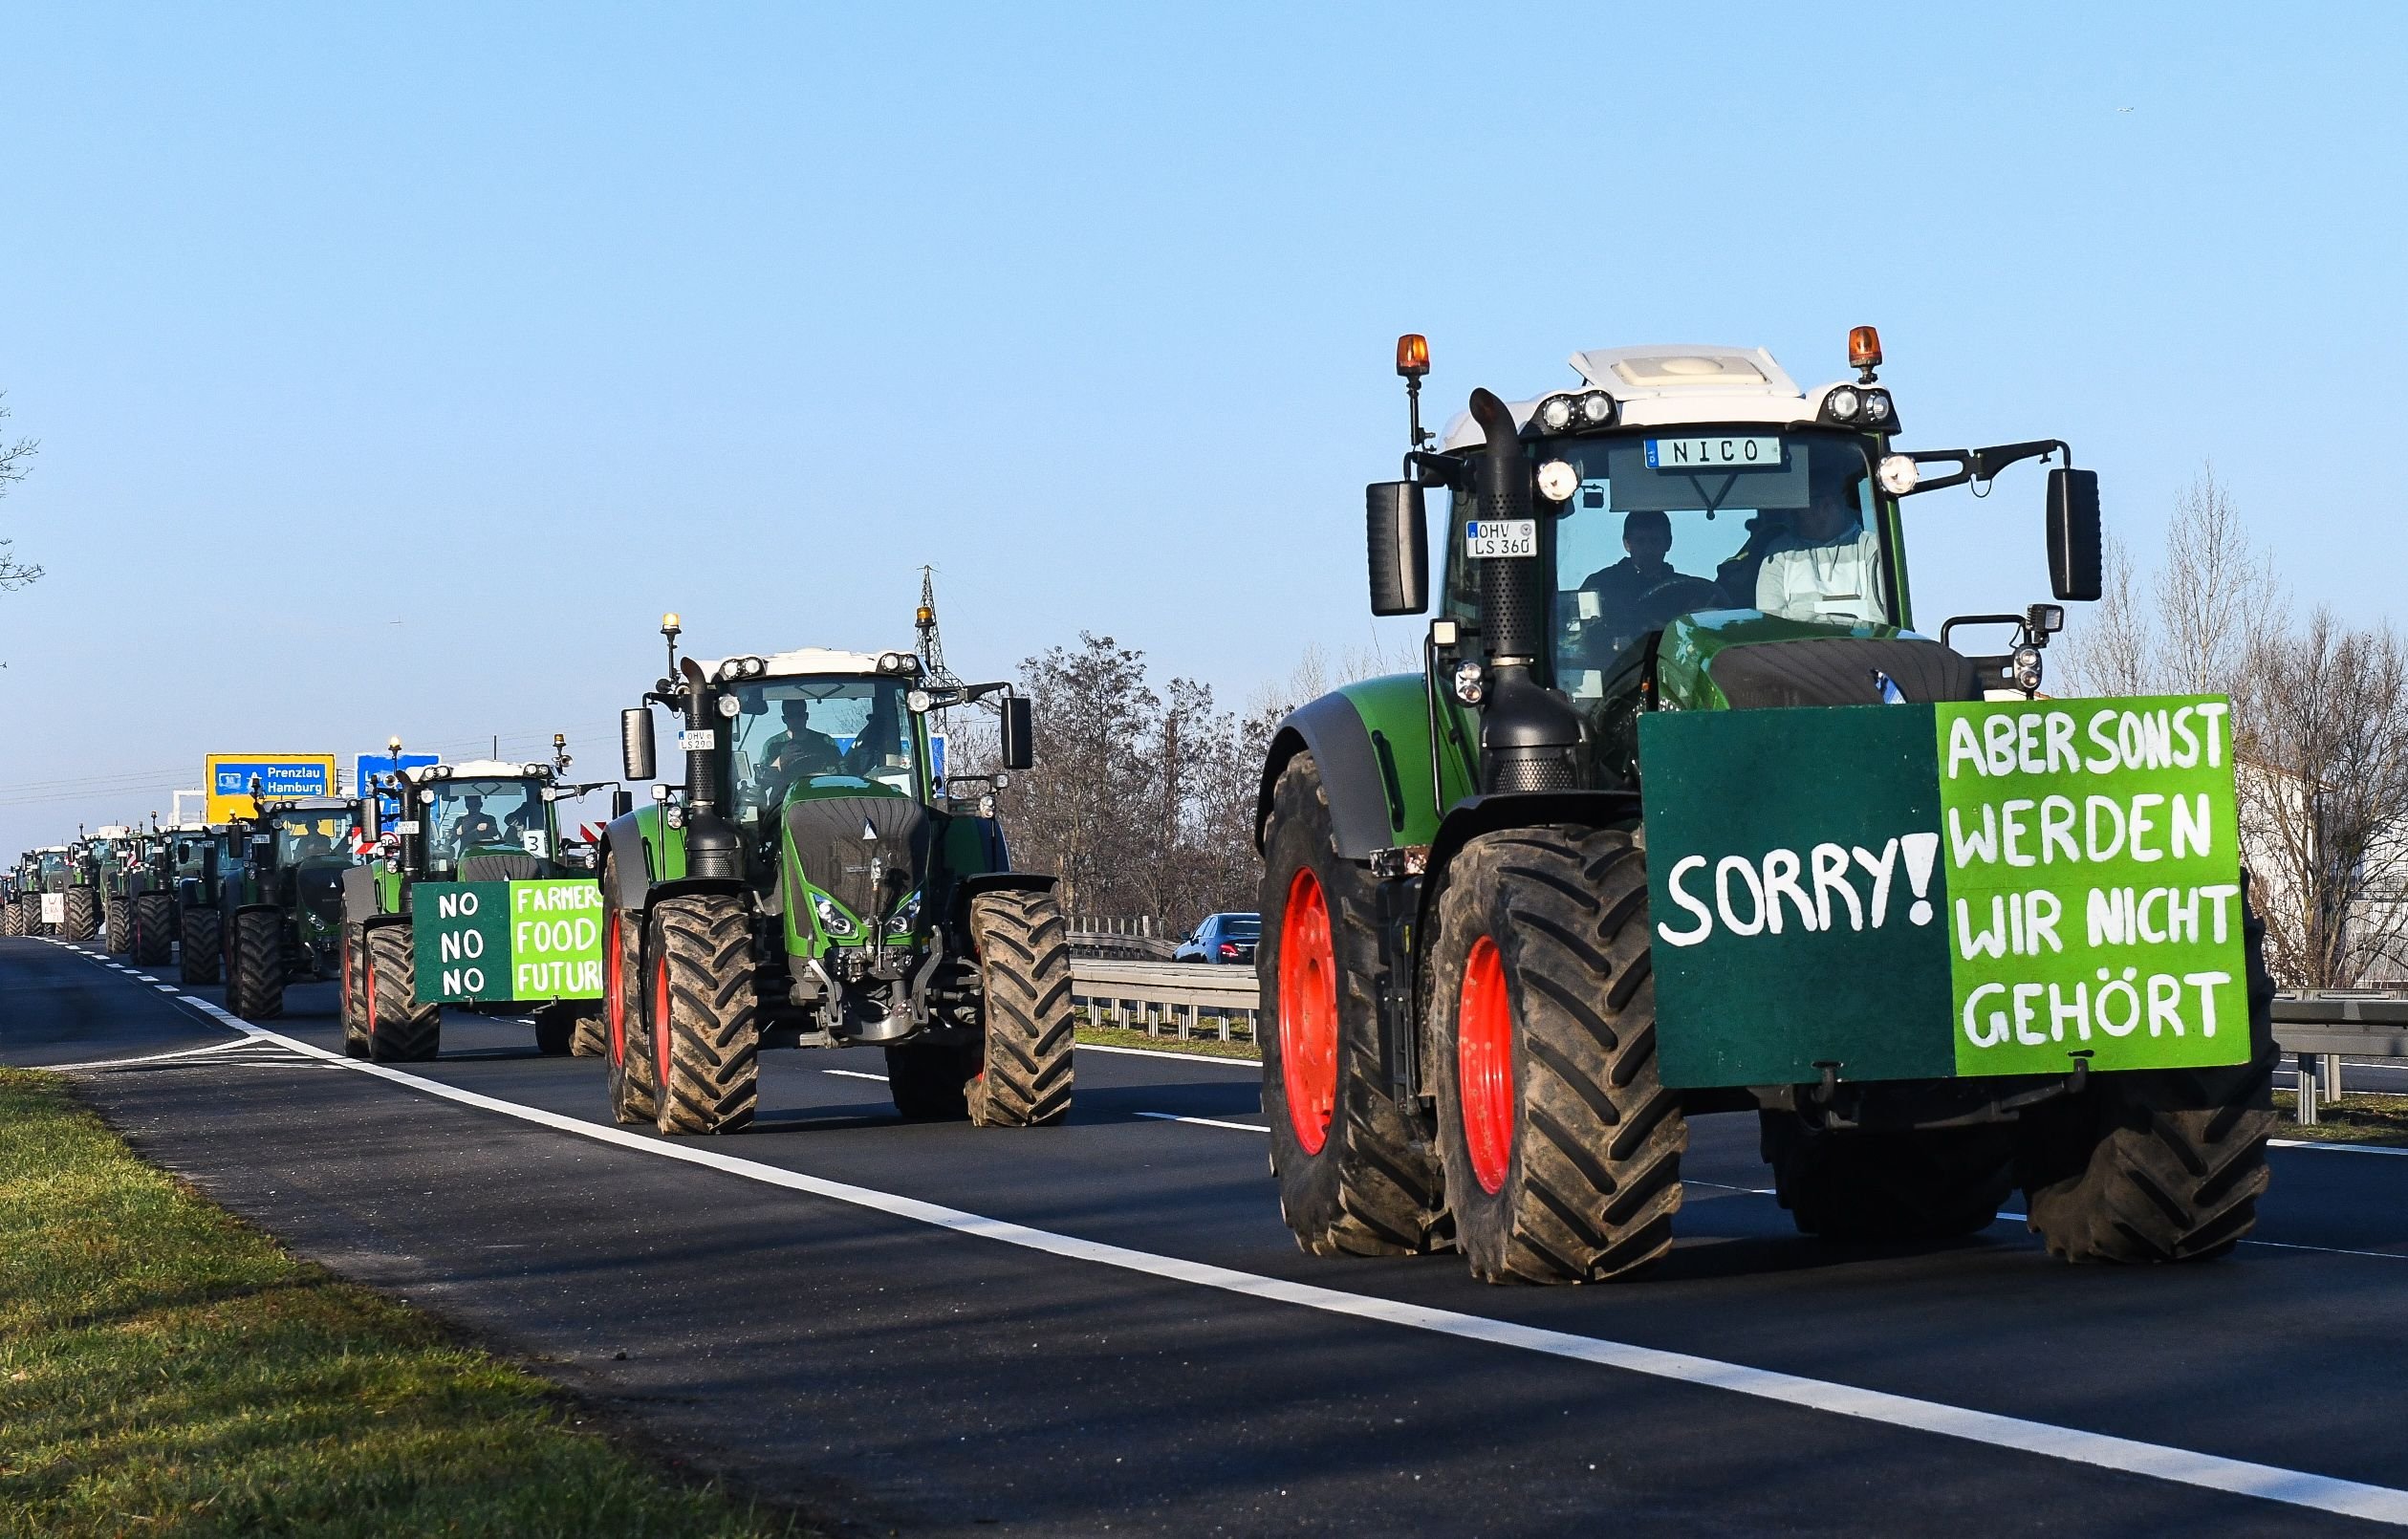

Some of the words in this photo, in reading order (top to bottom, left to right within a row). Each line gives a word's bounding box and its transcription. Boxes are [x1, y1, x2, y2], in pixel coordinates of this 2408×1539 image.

[1673, 439, 1758, 464] NICO
[1475, 540, 1495, 554] LS
[1501, 538, 1529, 553] 360
[1479, 524, 1509, 538] OHV
[1947, 711, 2080, 780] ABER
[2085, 703, 2228, 774] SONST
[268, 767, 320, 778] Prenzlau
[268, 782, 322, 795] Hamburg
[528, 835, 539, 852] 3
[1948, 792, 2212, 869] WERDEN
[1658, 832, 1940, 947] SORRY!
[439, 892, 479, 920] NO
[1955, 889, 2064, 961] WIR
[2086, 883, 2240, 948] NICHT
[441, 928, 484, 964] NO
[516, 917, 597, 954] FOOD
[443, 967, 485, 996] NO
[518, 959, 604, 994] FUTUR
[1962, 966, 2232, 1049] GEHÖRT
